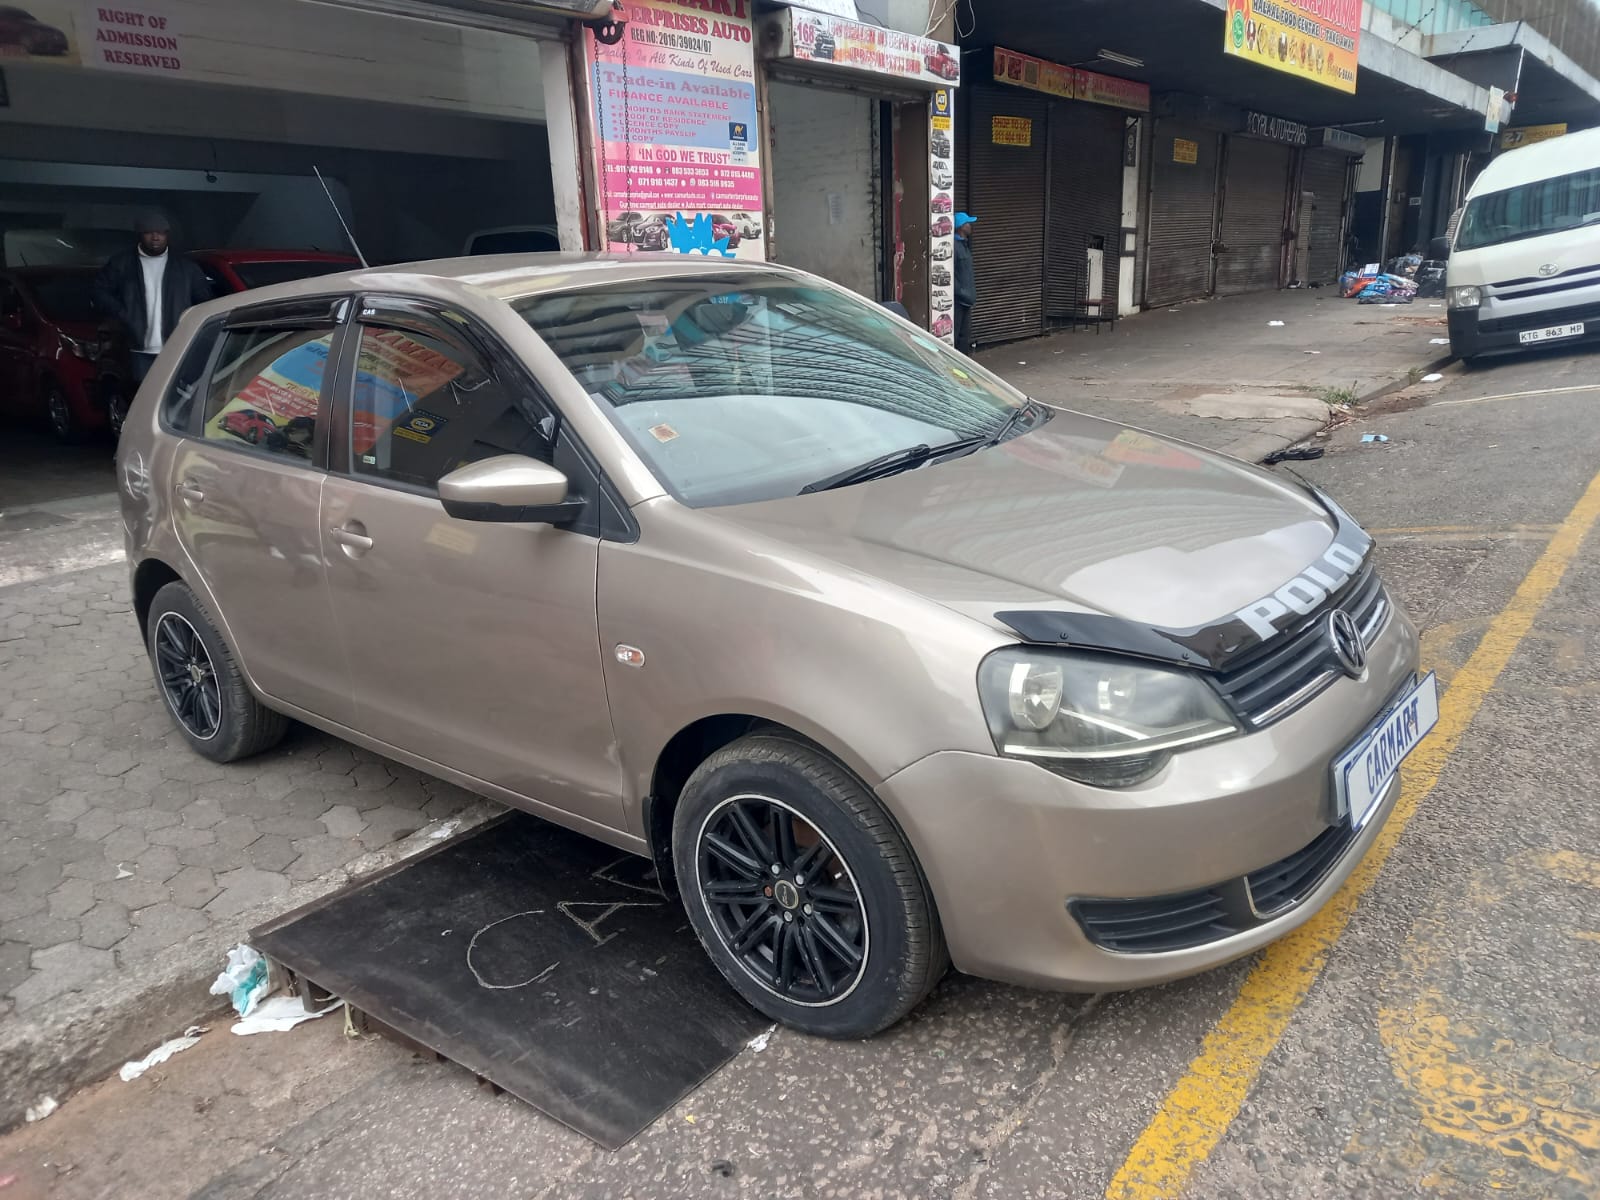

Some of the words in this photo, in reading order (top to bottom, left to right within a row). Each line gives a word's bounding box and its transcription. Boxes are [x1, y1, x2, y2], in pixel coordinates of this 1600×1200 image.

[97, 8, 145, 27] RIGHT
[148, 15, 167, 30] OF
[1280, 7, 1297, 29] FOOD
[96, 28, 178, 50] ADMISSION
[631, 27, 645, 41] REG
[711, 20, 753, 43] AUTO
[796, 23, 815, 43] 168
[103, 49, 181, 70] RESERVED
[649, 51, 666, 64] All
[669, 55, 695, 69] Kinds
[697, 59, 709, 74] Of
[709, 61, 732, 75] Used
[734, 65, 753, 78] Cars
[603, 70, 676, 90] Trade-in
[680, 80, 751, 100] Available
[608, 88, 663, 103] FINANCE
[667, 96, 729, 110] AVAILABLE
[658, 121, 679, 129] COPY
[656, 150, 677, 162] GOD
[680, 151, 695, 162] WE
[1521, 332, 1538, 340] KTG
[1545, 328, 1563, 337] 863
[1236, 542, 1363, 642] POLO
[1365, 696, 1419, 795] CARMART
